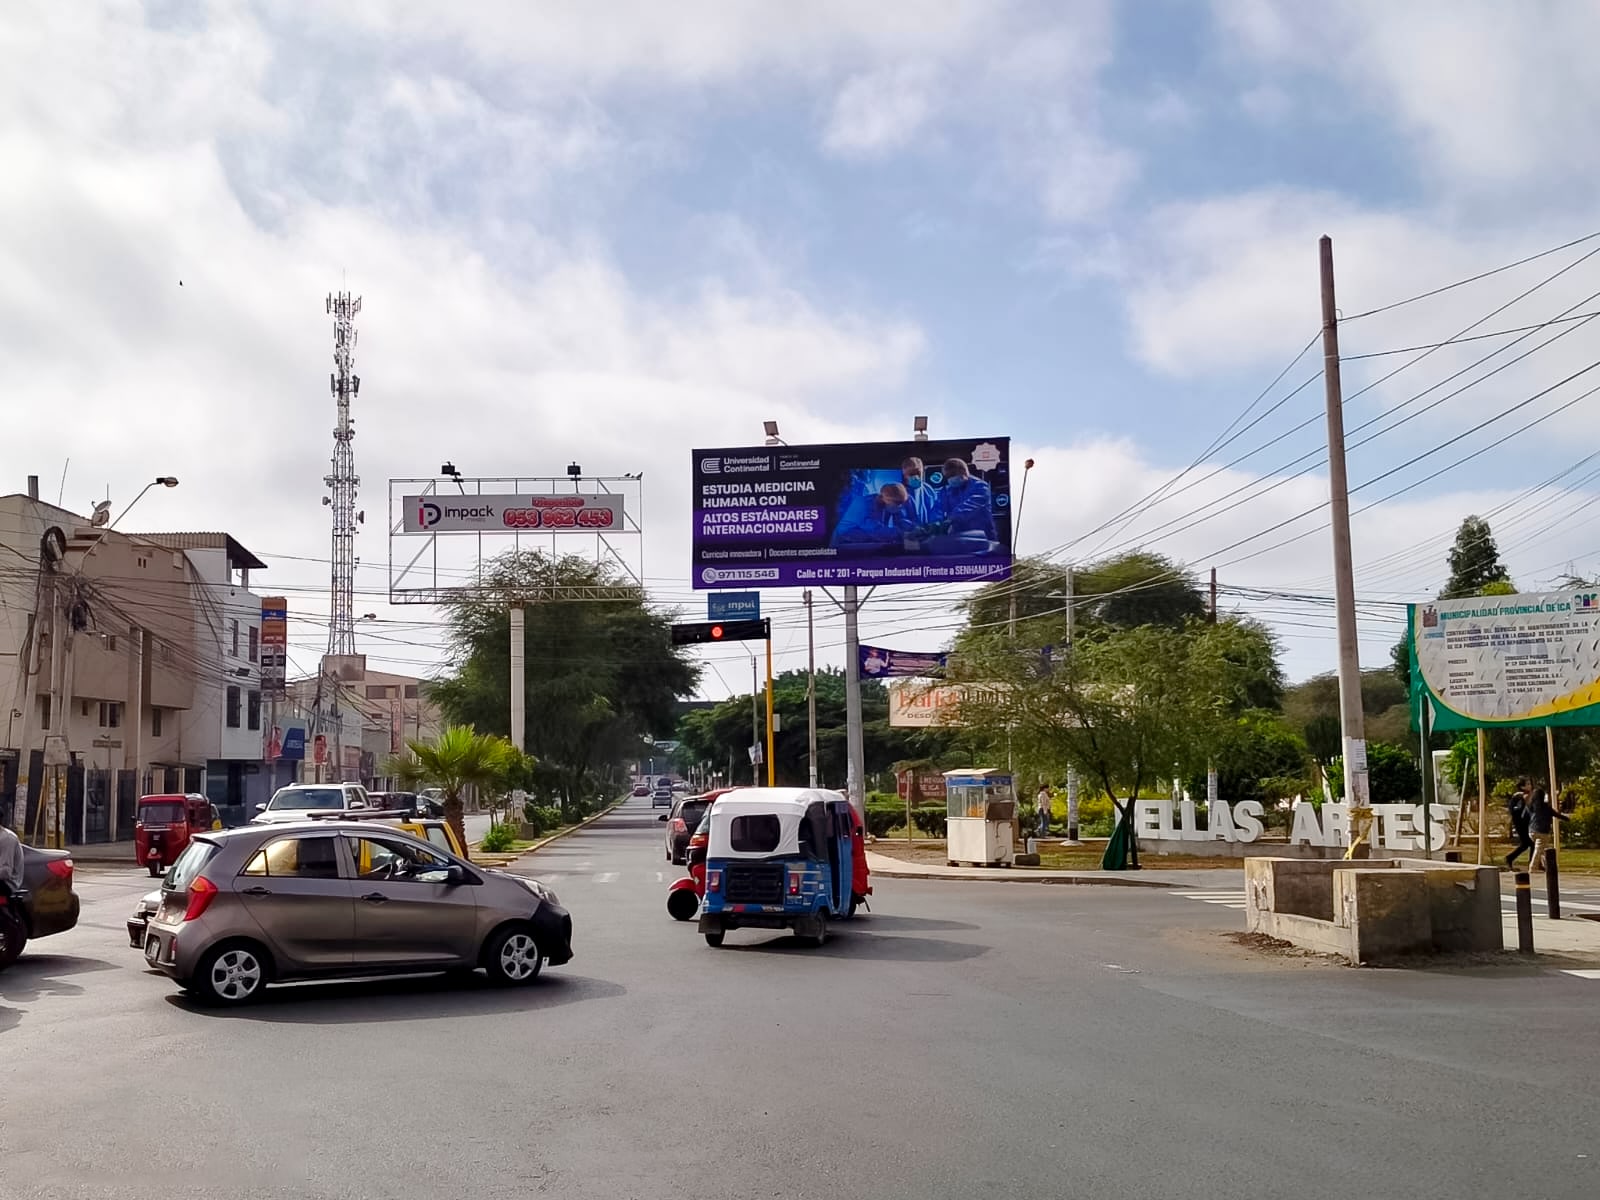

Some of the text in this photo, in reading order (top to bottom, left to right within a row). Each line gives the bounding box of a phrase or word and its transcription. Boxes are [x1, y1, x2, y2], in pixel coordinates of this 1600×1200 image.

[724, 456, 770, 465] Universidad
[724, 464, 770, 473] Continental
[702, 481, 816, 495] ESTUDIA MEDICINA
[702, 496, 787, 508] HUMANA CON
[702, 509, 818, 524] ALTOS ESTÁNDARES
[703, 522, 814, 535] INTERNACIONALES
[768, 548, 797, 557] Docentes
[718, 569, 776, 579] 971 115 546
[796, 569, 816, 578] Calle
[817, 569, 823, 578] C
[836, 568, 850, 578] 201
[856, 568, 884, 578] Parque
[884, 566, 922, 577] Industrial
[923, 566, 948, 577] (Frente
[955, 565, 987, 575] SENHAMI
[1440, 608, 1498, 620] MUNICIPALIDAD
[1500, 604, 1544, 616] PROVINCIAL
[1546, 604, 1556, 612] DE
[1557, 602, 1571, 611] ICA
[1114, 798, 1264, 843] ELLAS
